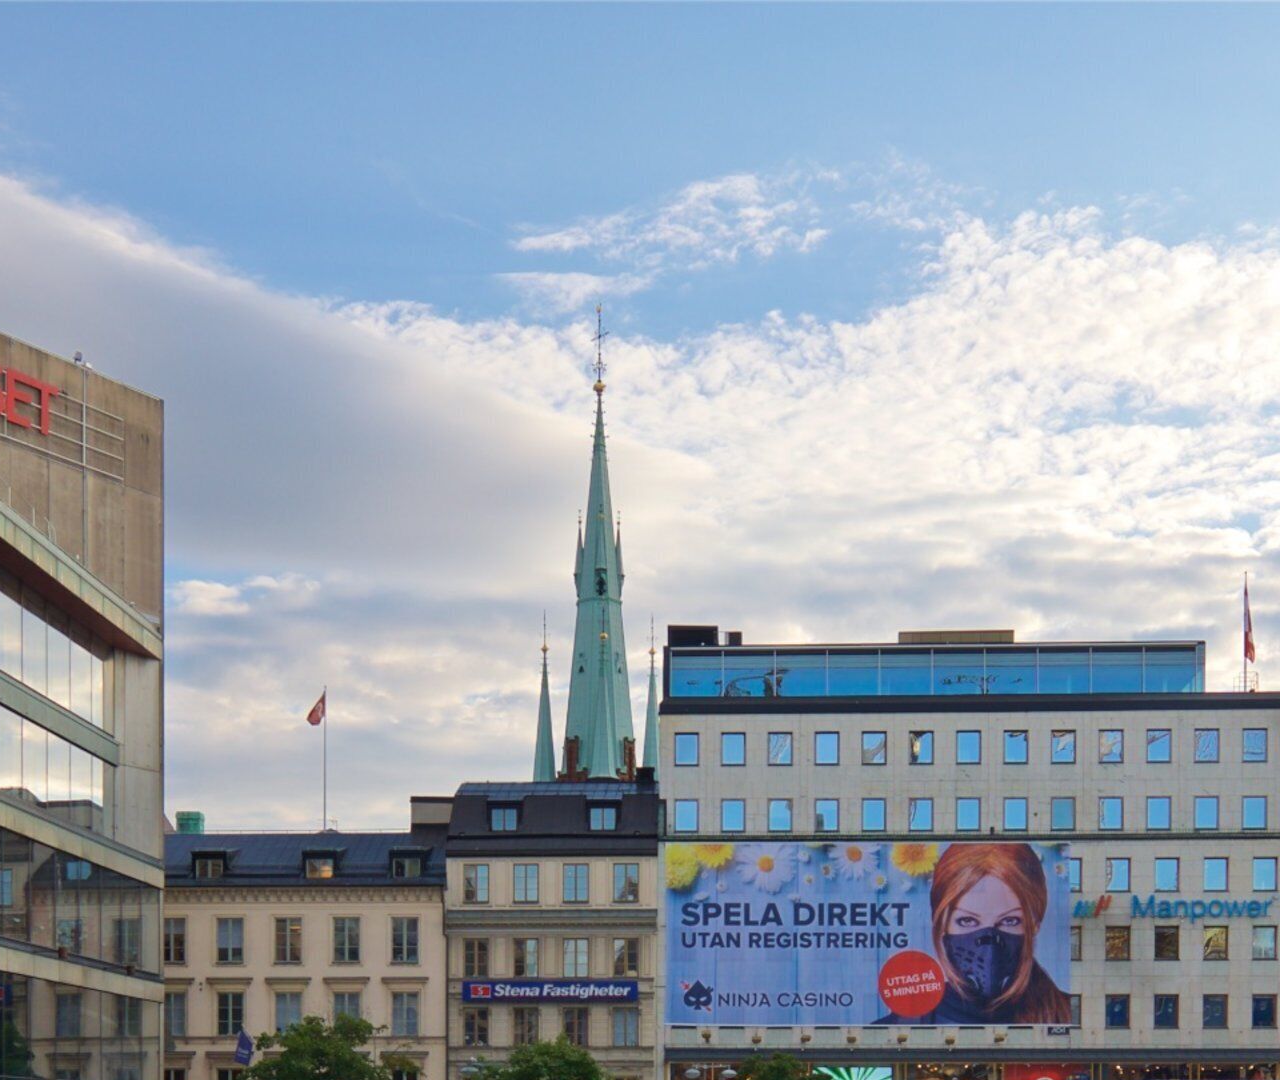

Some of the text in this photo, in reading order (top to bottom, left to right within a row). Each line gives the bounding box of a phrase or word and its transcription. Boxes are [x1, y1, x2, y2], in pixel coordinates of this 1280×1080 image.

[681, 902, 910, 926] SPELA DIREKT
[1131, 894, 1274, 924] Manpower
[681, 932, 909, 949] UTAN REGISTRERING
[886, 970, 935, 987] UTTAG PÅ
[494, 984, 631, 999] Stena Fastigheter
[884, 982, 942, 999] 5 MINUTER!
[717, 992, 854, 1008] NINJA CASINO
